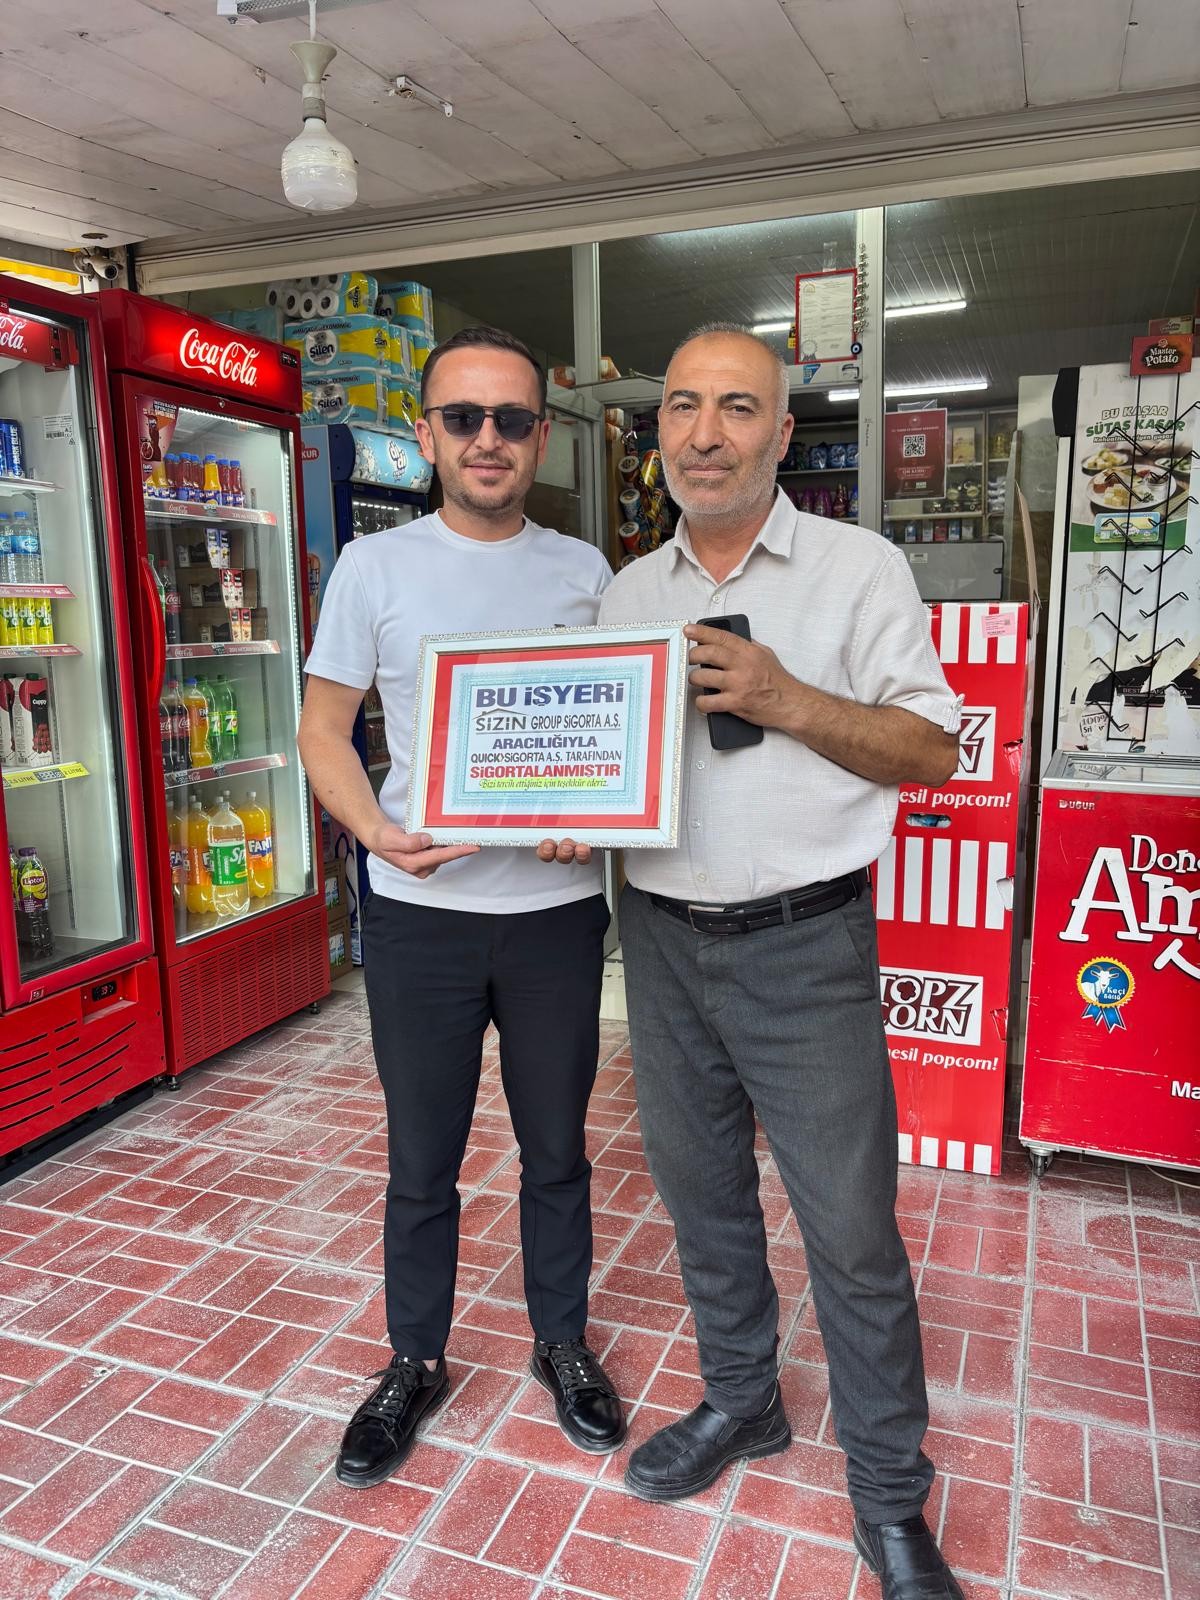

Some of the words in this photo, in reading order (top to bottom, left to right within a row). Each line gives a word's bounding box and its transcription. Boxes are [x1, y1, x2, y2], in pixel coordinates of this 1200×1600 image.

[180, 328, 260, 386] Coca-Cola
[310, 344, 335, 359] Silen
[1150, 347, 1177, 356] Master
[1145, 354, 1179, 367] Potato
[1101, 408, 1120, 421] BU
[476, 687, 517, 707] BU
[531, 716, 562, 730] GROUP
[604, 713, 621, 729] A.Ş.
[492, 735, 598, 749] ARACILIĞIYLA
[566, 751, 622, 761] TARAFINDAN
[496, 779, 514, 788] tercih
[514, 779, 542, 790] ettiğiniz
[544, 779, 556, 789] için
[557, 778, 585, 788] teşekkür
[899, 789, 928, 804] esil
[932, 792, 1012, 809] popcorn!
[22, 876, 45, 886] Lipton
[922, 1052, 998, 1070] popcorn!
